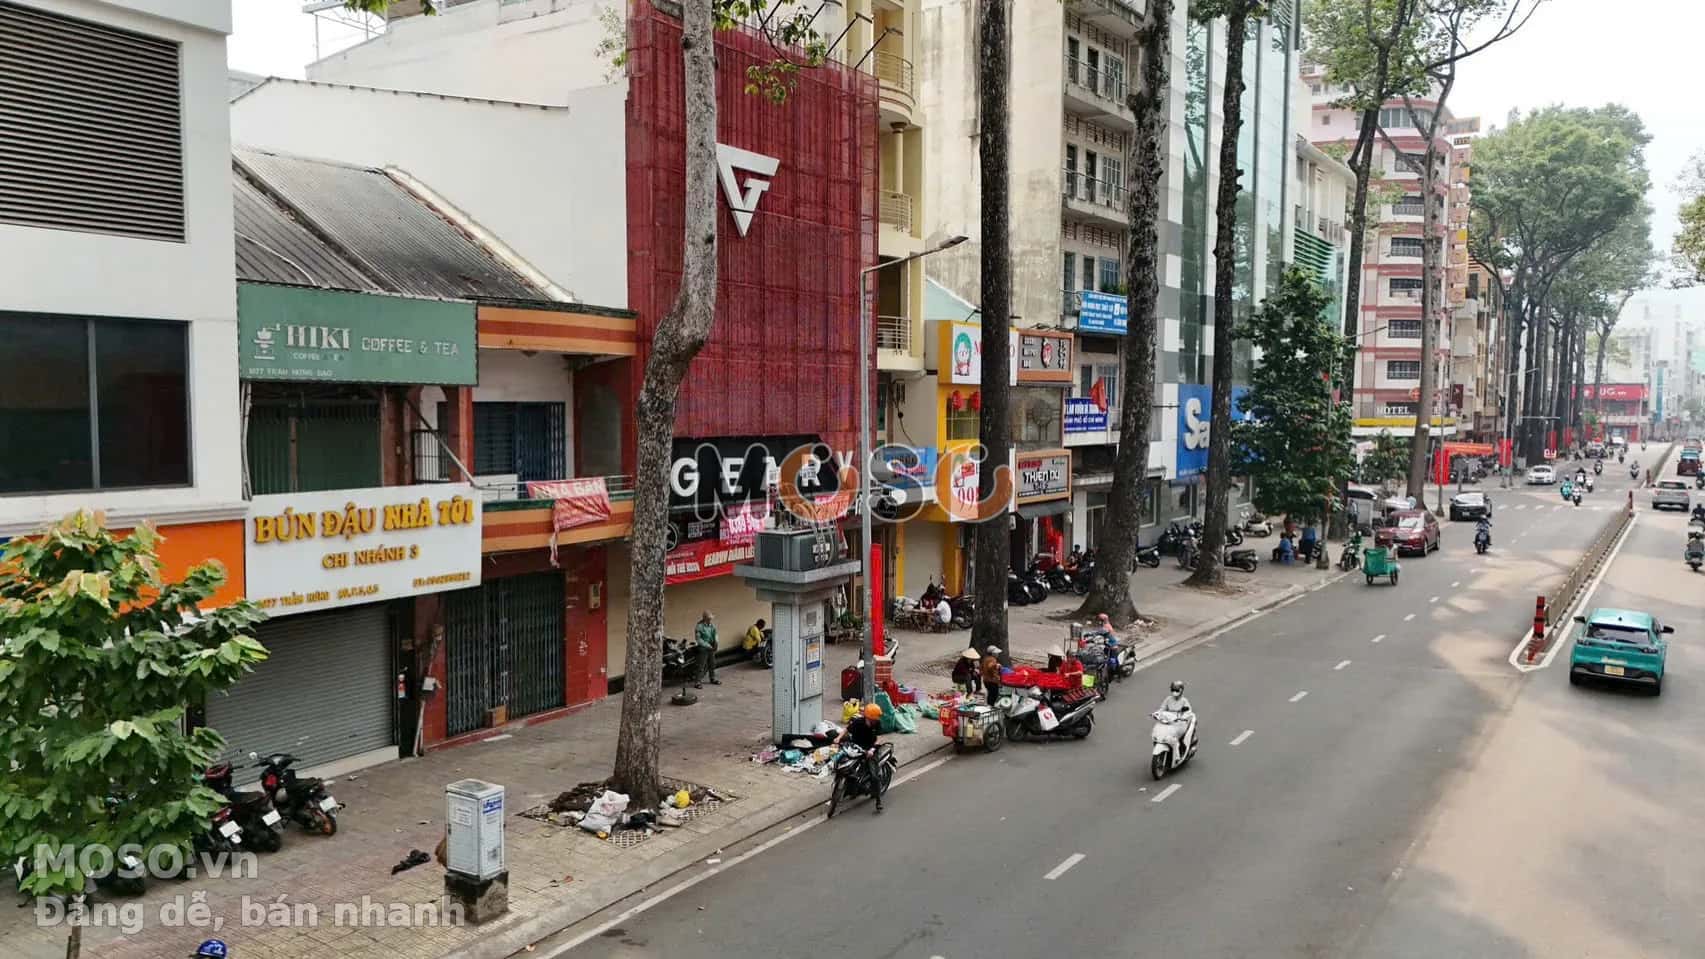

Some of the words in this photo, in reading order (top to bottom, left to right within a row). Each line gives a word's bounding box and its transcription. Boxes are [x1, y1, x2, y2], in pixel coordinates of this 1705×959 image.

[286, 325, 350, 351] HIKI
[361, 337, 413, 353] COFFEE
[418, 340, 428, 354] &
[433, 341, 460, 357] TEA
[1376, 405, 1410, 416] HOTEL
[254, 506, 318, 544] BÚN
[321, 501, 377, 541] ĐẬU
[383, 497, 433, 531] NHÀ
[437, 495, 474, 525] TÔI
[322, 552, 348, 568] CHI
[354, 543, 406, 566] NHÁNH
